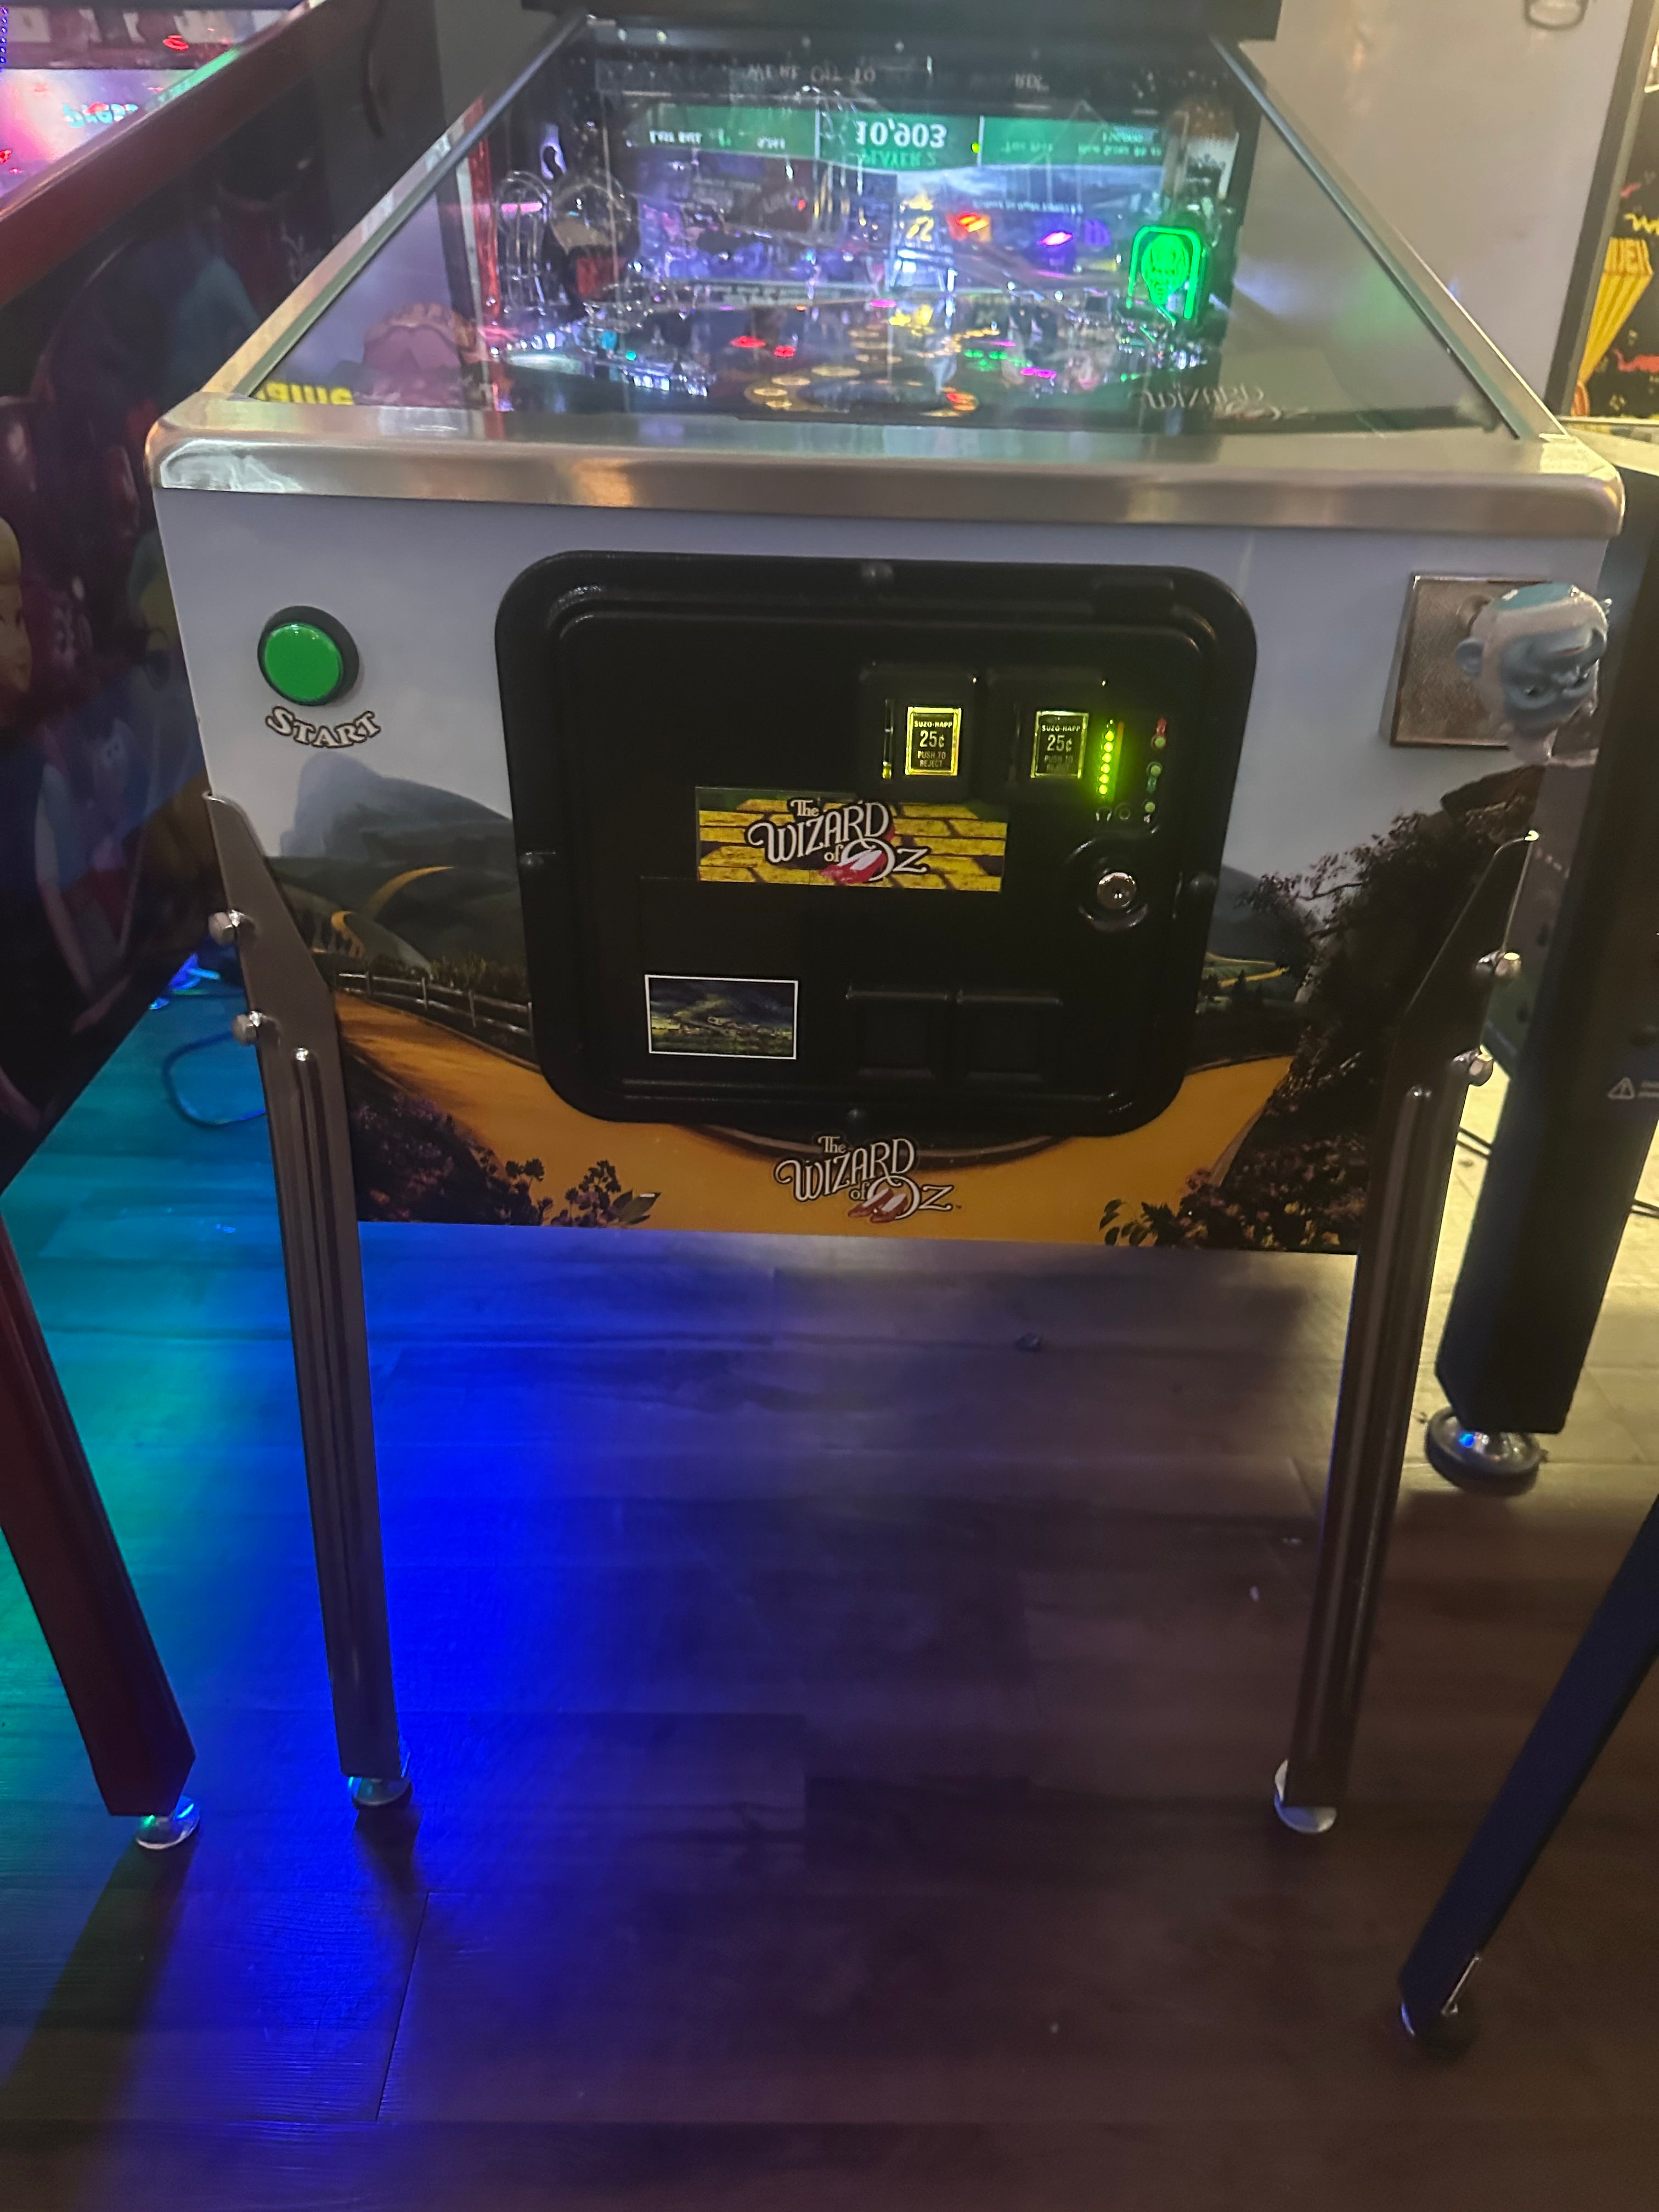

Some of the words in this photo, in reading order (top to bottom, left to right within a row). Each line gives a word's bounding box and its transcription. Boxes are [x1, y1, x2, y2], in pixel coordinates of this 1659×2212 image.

[266, 706, 381, 748] START
[919, 730, 945, 749] 25¢
[1047, 734, 1073, 753] 25¢
[917, 751, 935, 759] PUSH
[790, 799, 820, 817] The
[747, 802, 889, 863] WIZARD
[824, 843, 843, 863] of
[817, 1136, 848, 1153] The
[774, 1138, 915, 1201] WIZARD
[850, 1182, 870, 1200] of
